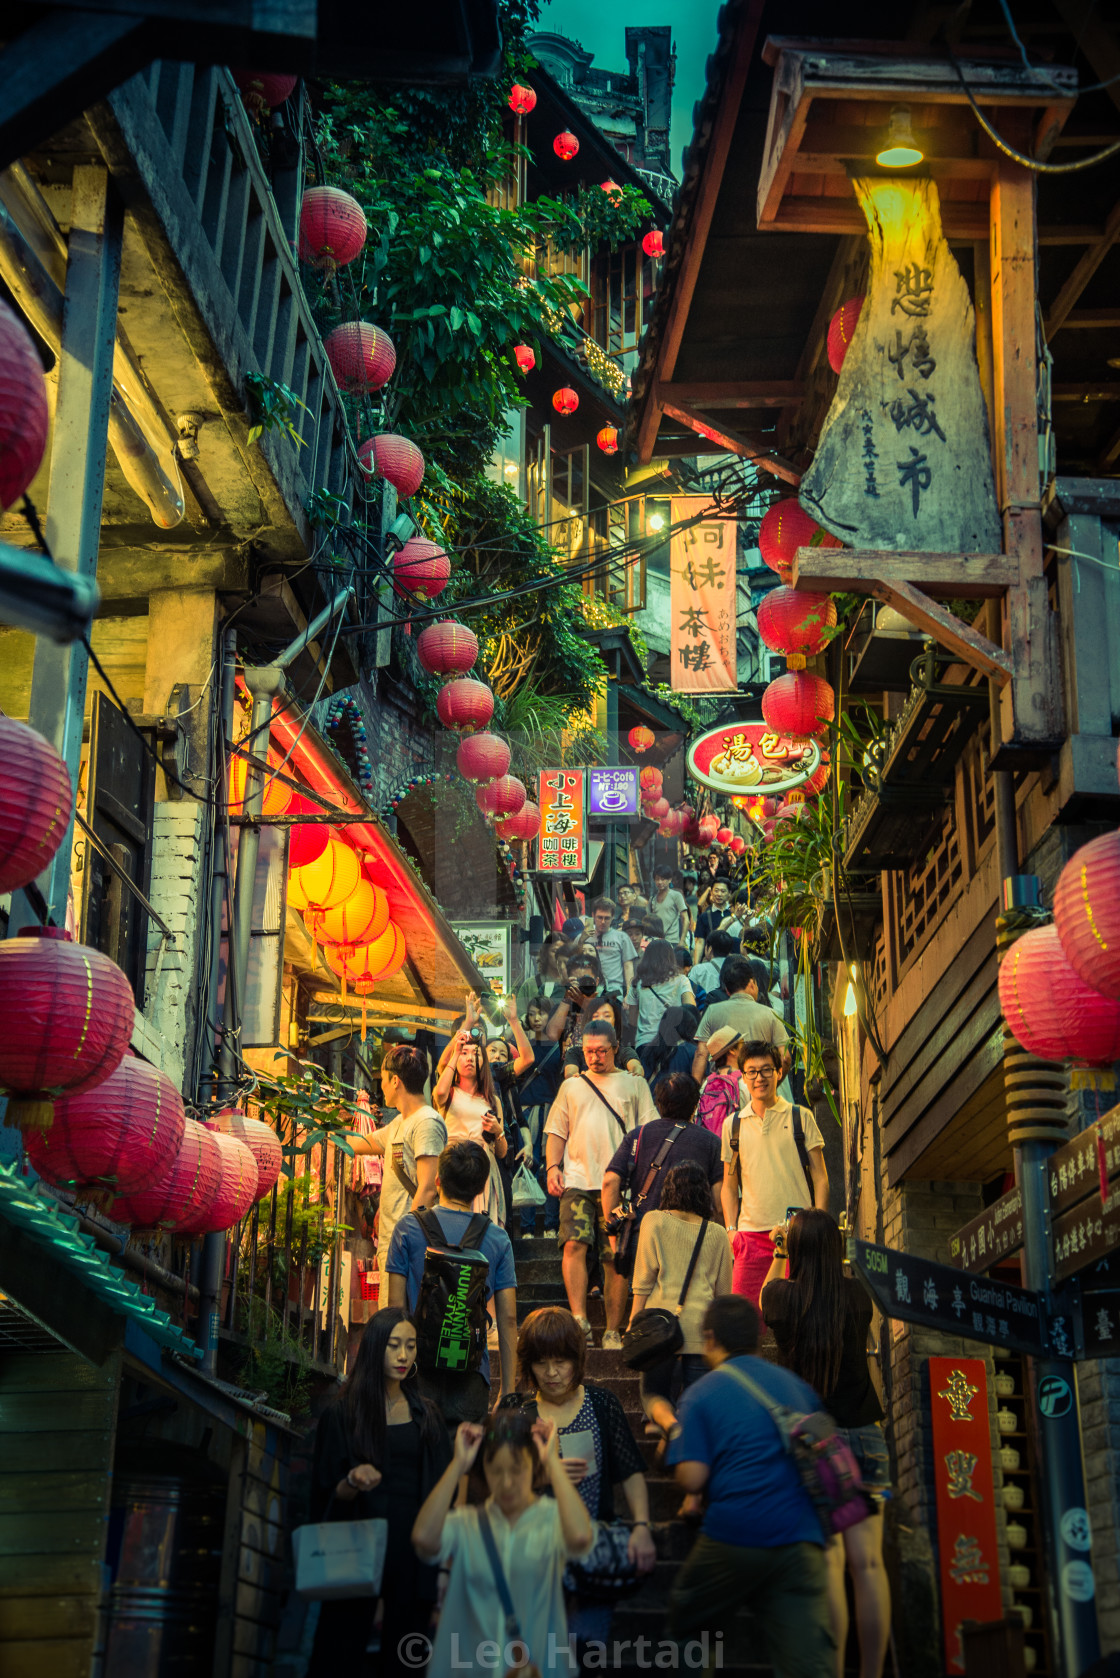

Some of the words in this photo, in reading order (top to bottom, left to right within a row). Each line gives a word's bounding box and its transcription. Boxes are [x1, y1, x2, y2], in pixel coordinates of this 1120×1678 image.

[887, 261, 947, 520] 悲情城市
[721, 732, 789, 761] 湯包
[546, 772, 578, 835] 小上海
[543, 838, 578, 850] 咖啡
[543, 853, 578, 867] 茶樓
[865, 1248, 889, 1275] 505M
[450, 1265, 473, 1339] NUMANNI
[895, 1267, 967, 1318] 觀海亭
[970, 1279, 1005, 1309] Guanhai
[1005, 1290, 1039, 1319] Pavilion
[441, 1293, 458, 1337] STYLE
[938, 1369, 990, 1671] 童叟無
